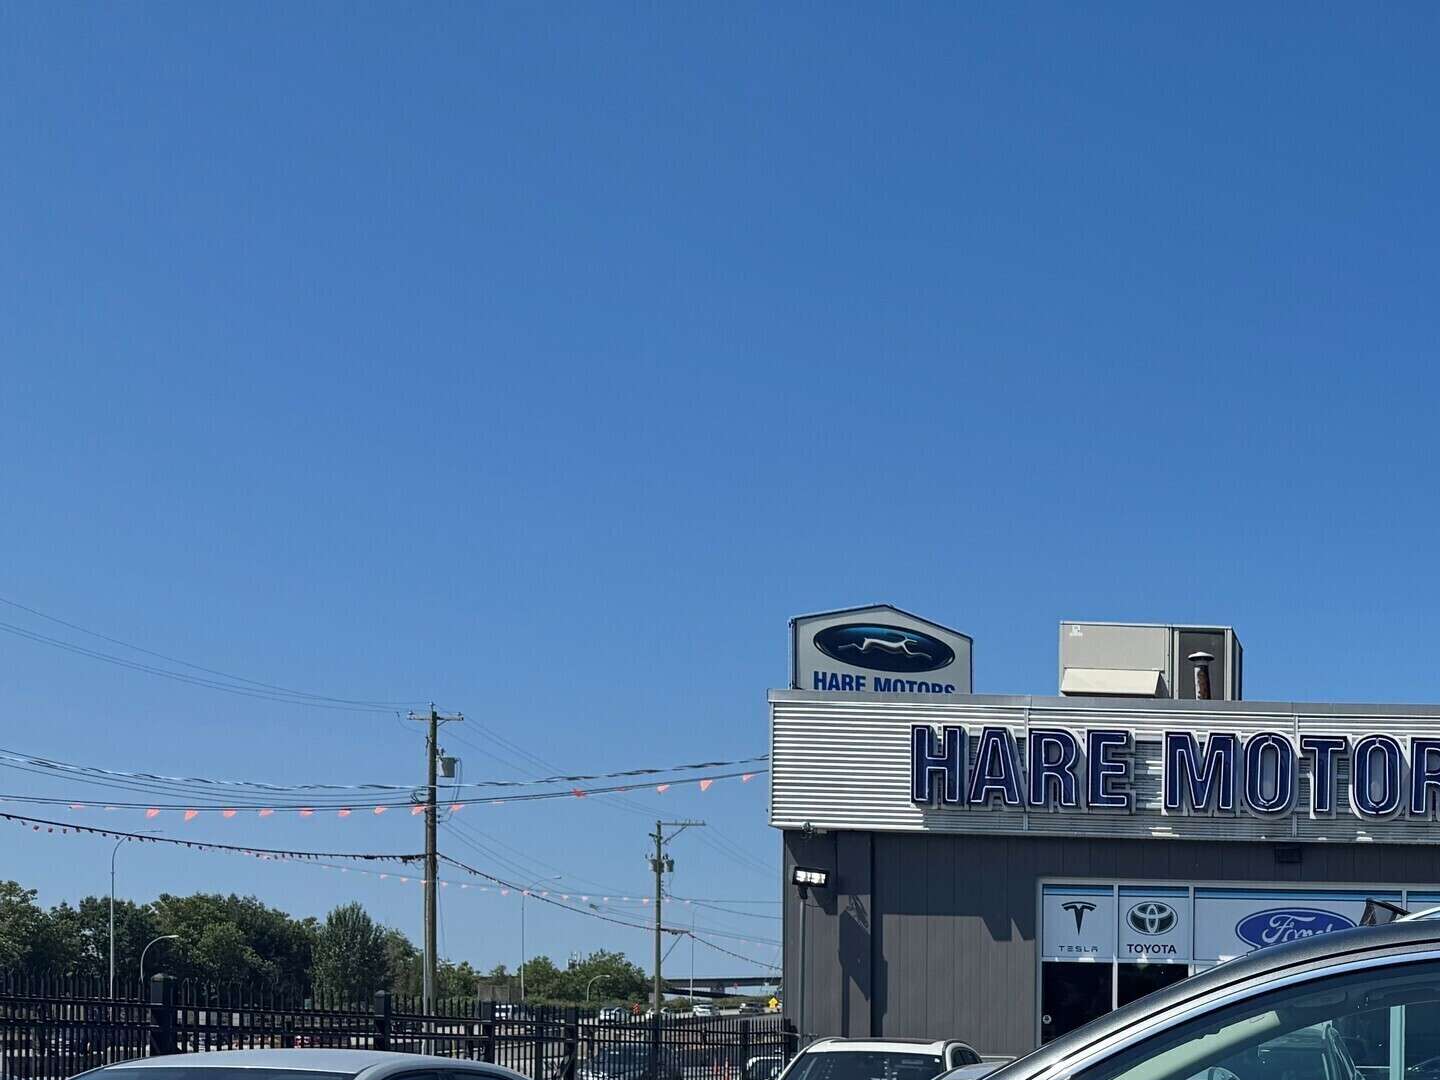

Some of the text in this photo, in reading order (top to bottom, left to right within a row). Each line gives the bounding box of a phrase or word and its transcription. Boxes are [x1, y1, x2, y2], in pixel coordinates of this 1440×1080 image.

[909, 723, 1133, 809] HARE
[1058, 945, 1098, 953] TESLA
[1127, 943, 1177, 955] TOYOTA
